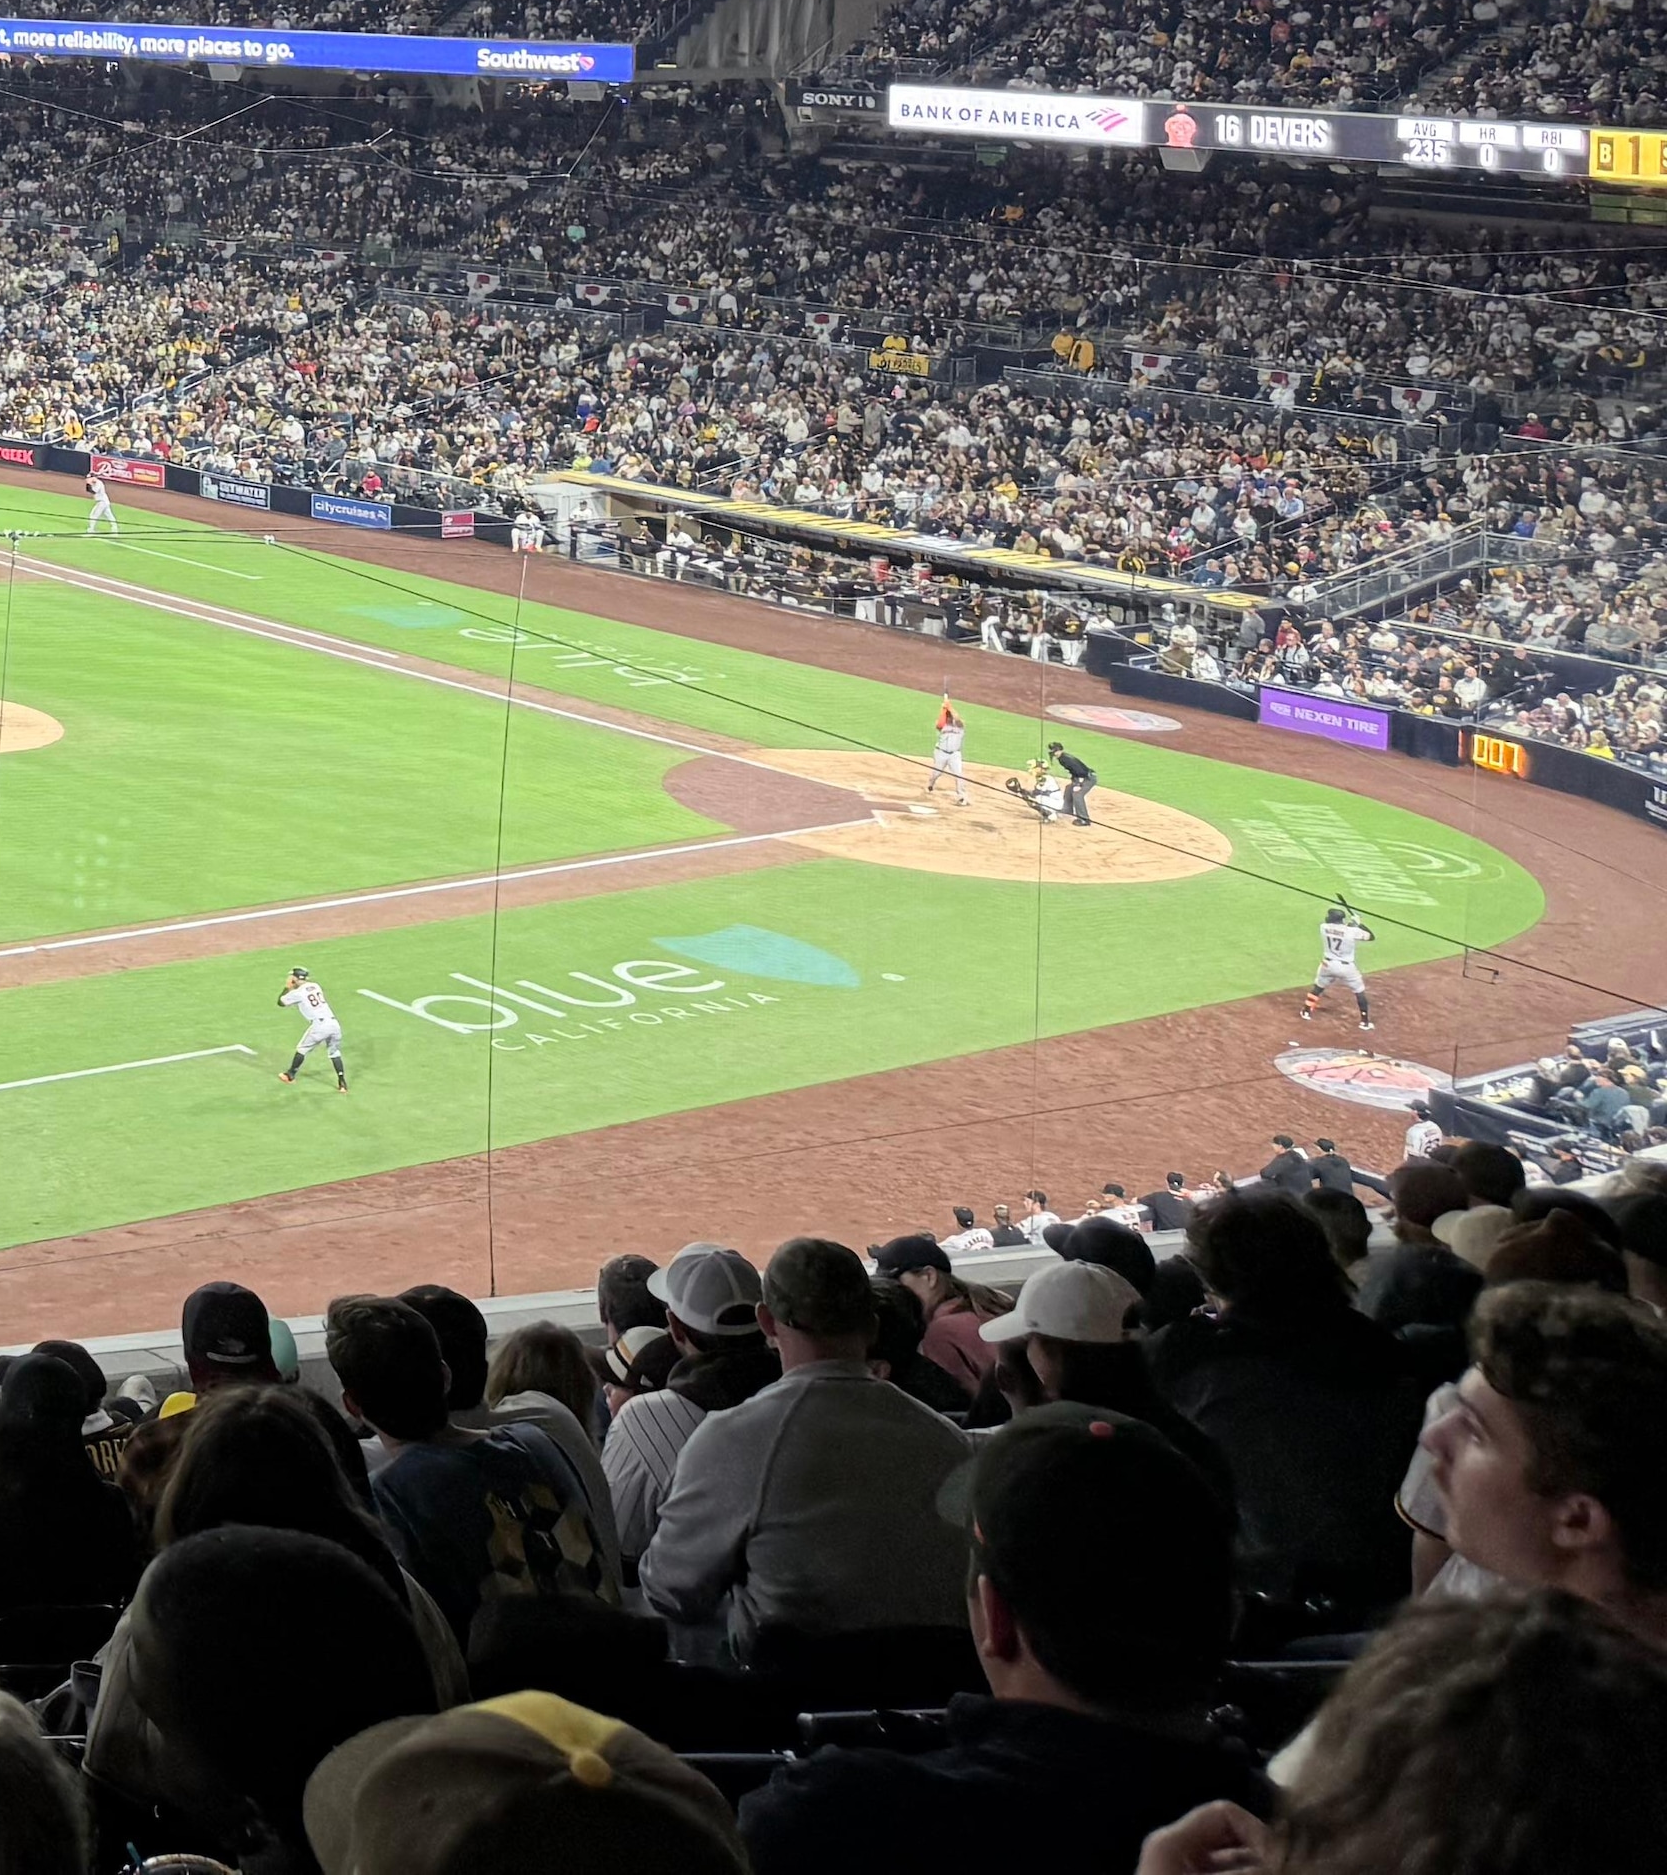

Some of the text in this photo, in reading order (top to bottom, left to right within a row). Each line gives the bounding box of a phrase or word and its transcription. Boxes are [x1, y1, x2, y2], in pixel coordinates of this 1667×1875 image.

[14, 32, 55, 46] more
[58, 30, 137, 55] reliability,
[141, 37, 184, 53] more
[187, 36, 241, 59] places
[244, 40, 263, 55] to
[266, 42, 295, 61] go.
[477, 48, 579, 72] Southwest
[803, 92, 853, 107] SONY
[901, 104, 1080, 129] BANK OF AMERICA
[1216, 114, 1329, 148] 16 DEVERS
[1413, 123, 1563, 145] AVG HR RBI
[1403, 139, 1559, 171] .235 0 0
[1600, 143, 1611, 163] B
[1629, 136, 1640, 174] 1
[315, 500, 376, 521] citycruises
[1294, 708, 1342, 726] NEXEN
[1347, 719, 1379, 735] TIRE
[357, 960, 725, 1034] blue
[491, 992, 780, 1052] CALIFORNIA
